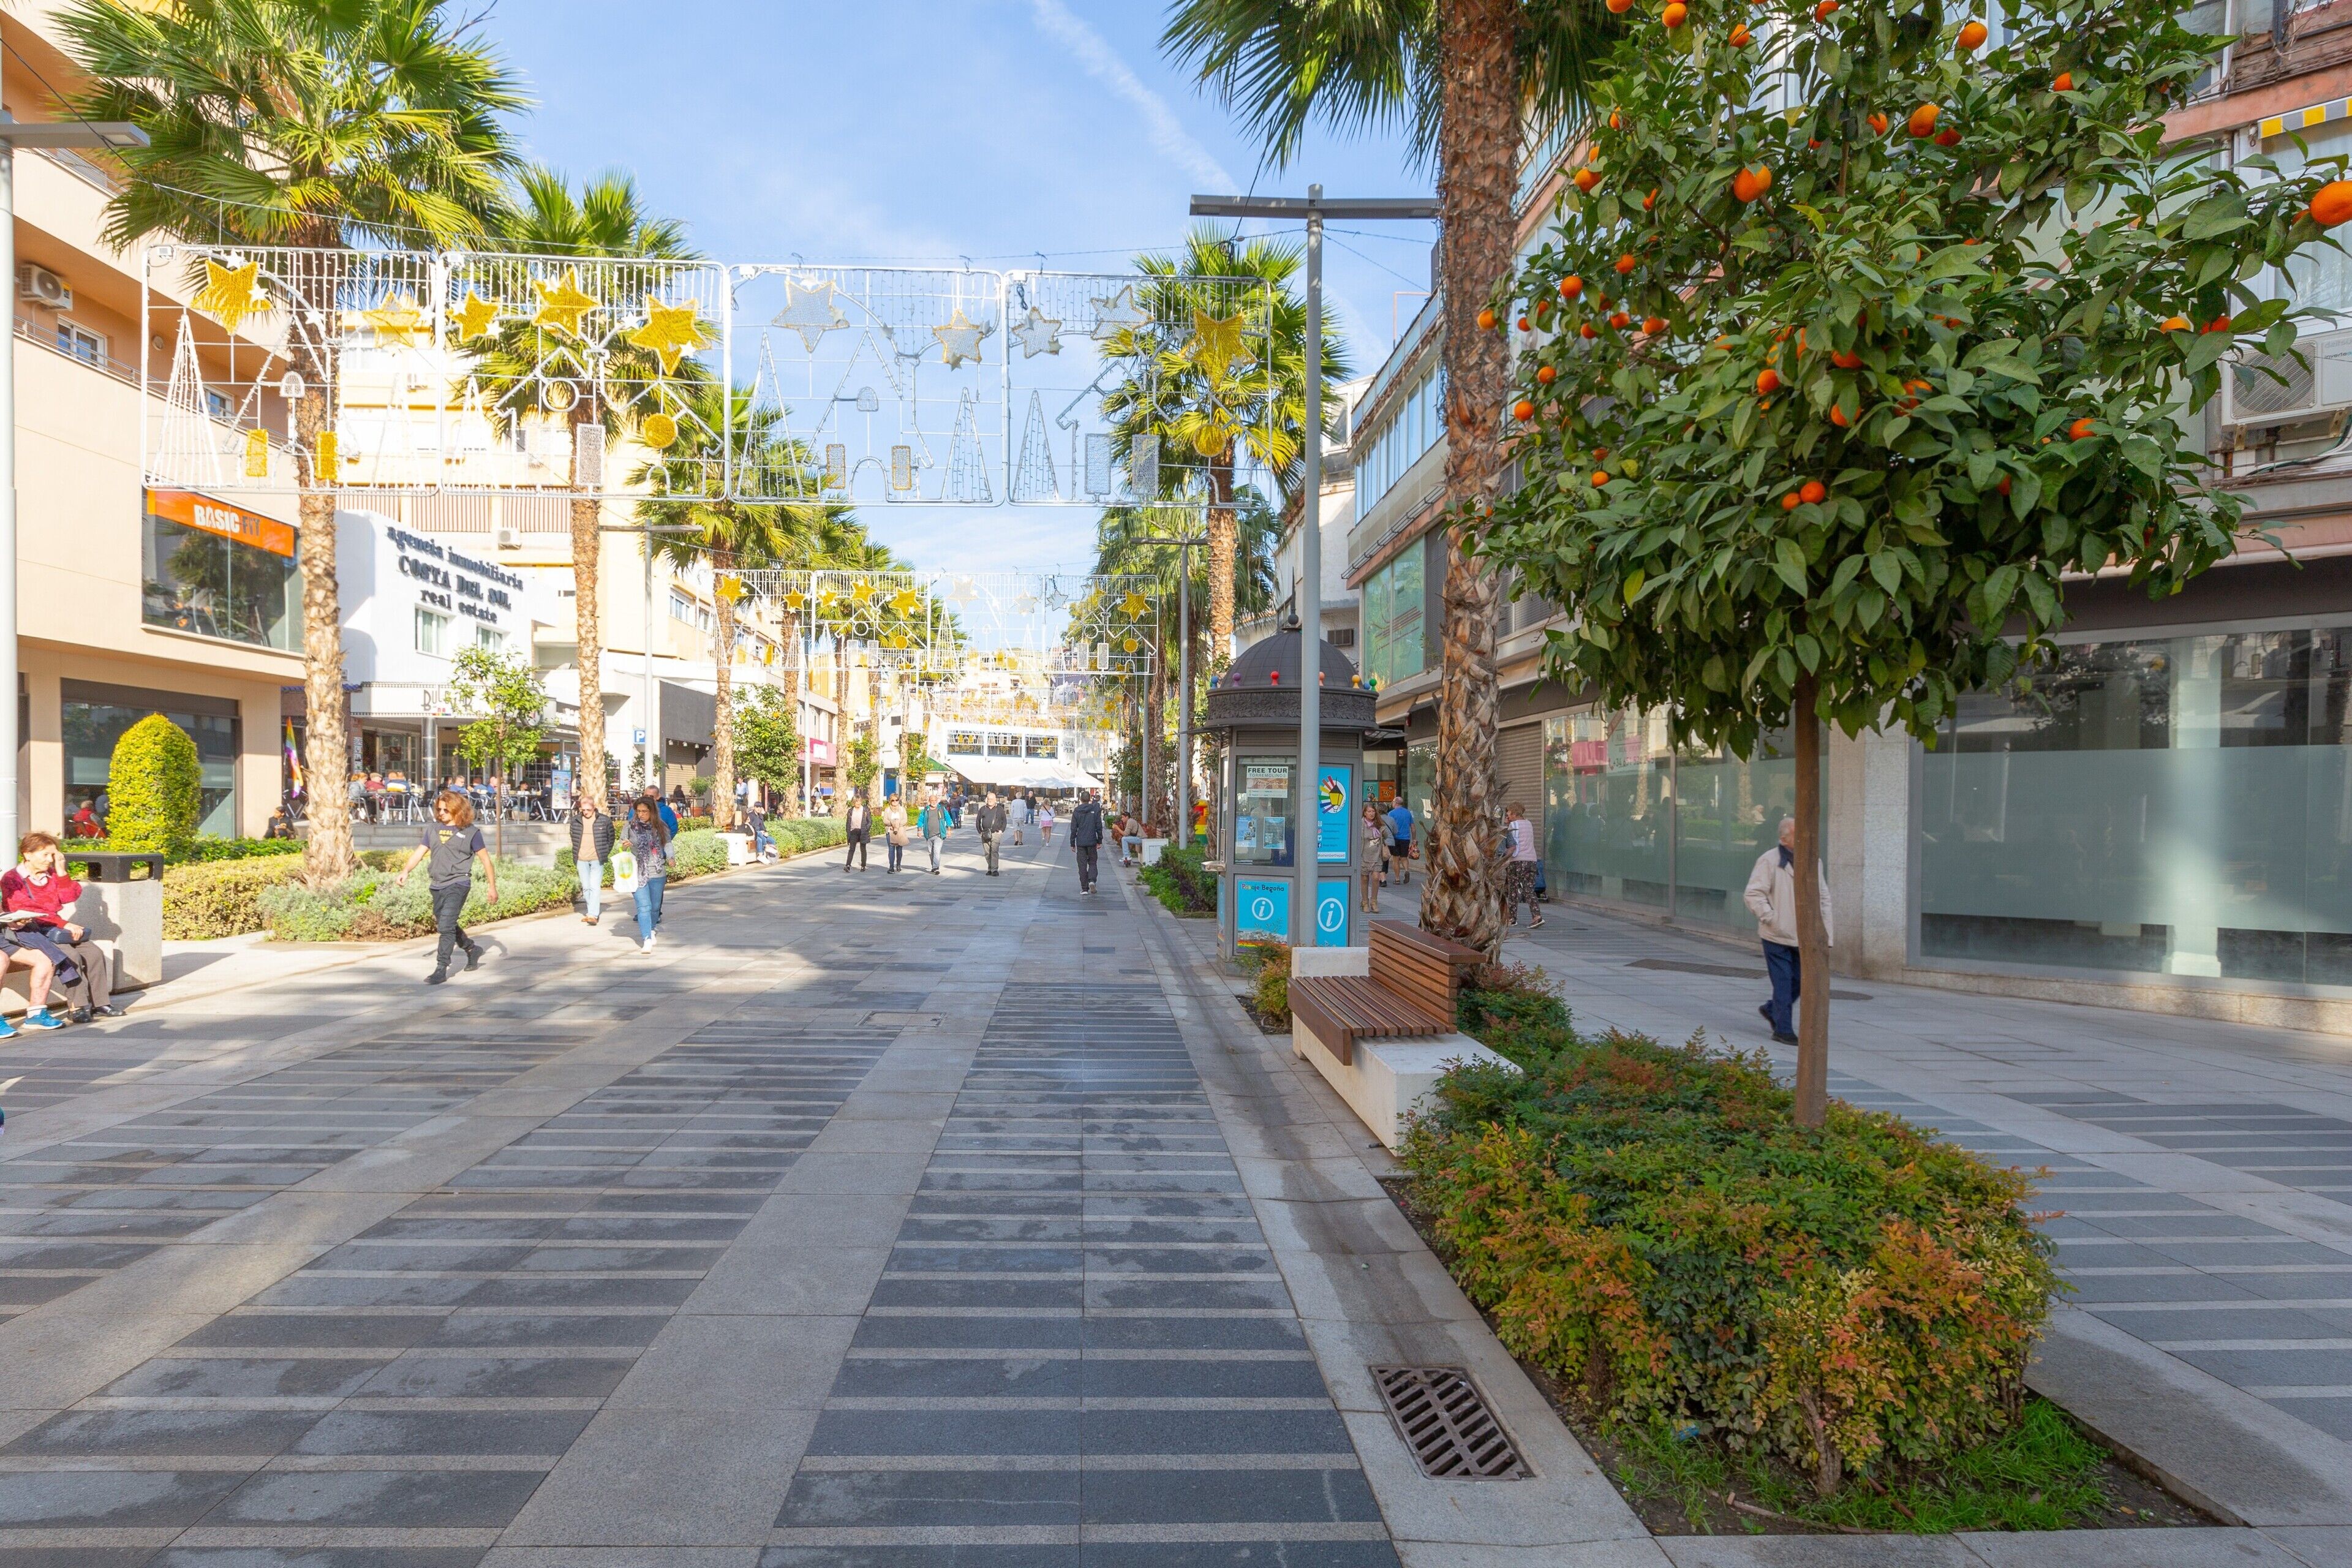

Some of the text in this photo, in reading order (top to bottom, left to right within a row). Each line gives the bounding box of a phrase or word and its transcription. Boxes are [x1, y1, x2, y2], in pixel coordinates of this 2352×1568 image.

[386, 526, 523, 591] agencia inmobiliaria
[398, 555, 511, 611] COSTA DEL SOL
[420, 589, 497, 624] real estate
[1262, 884, 1284, 893] Begoña
